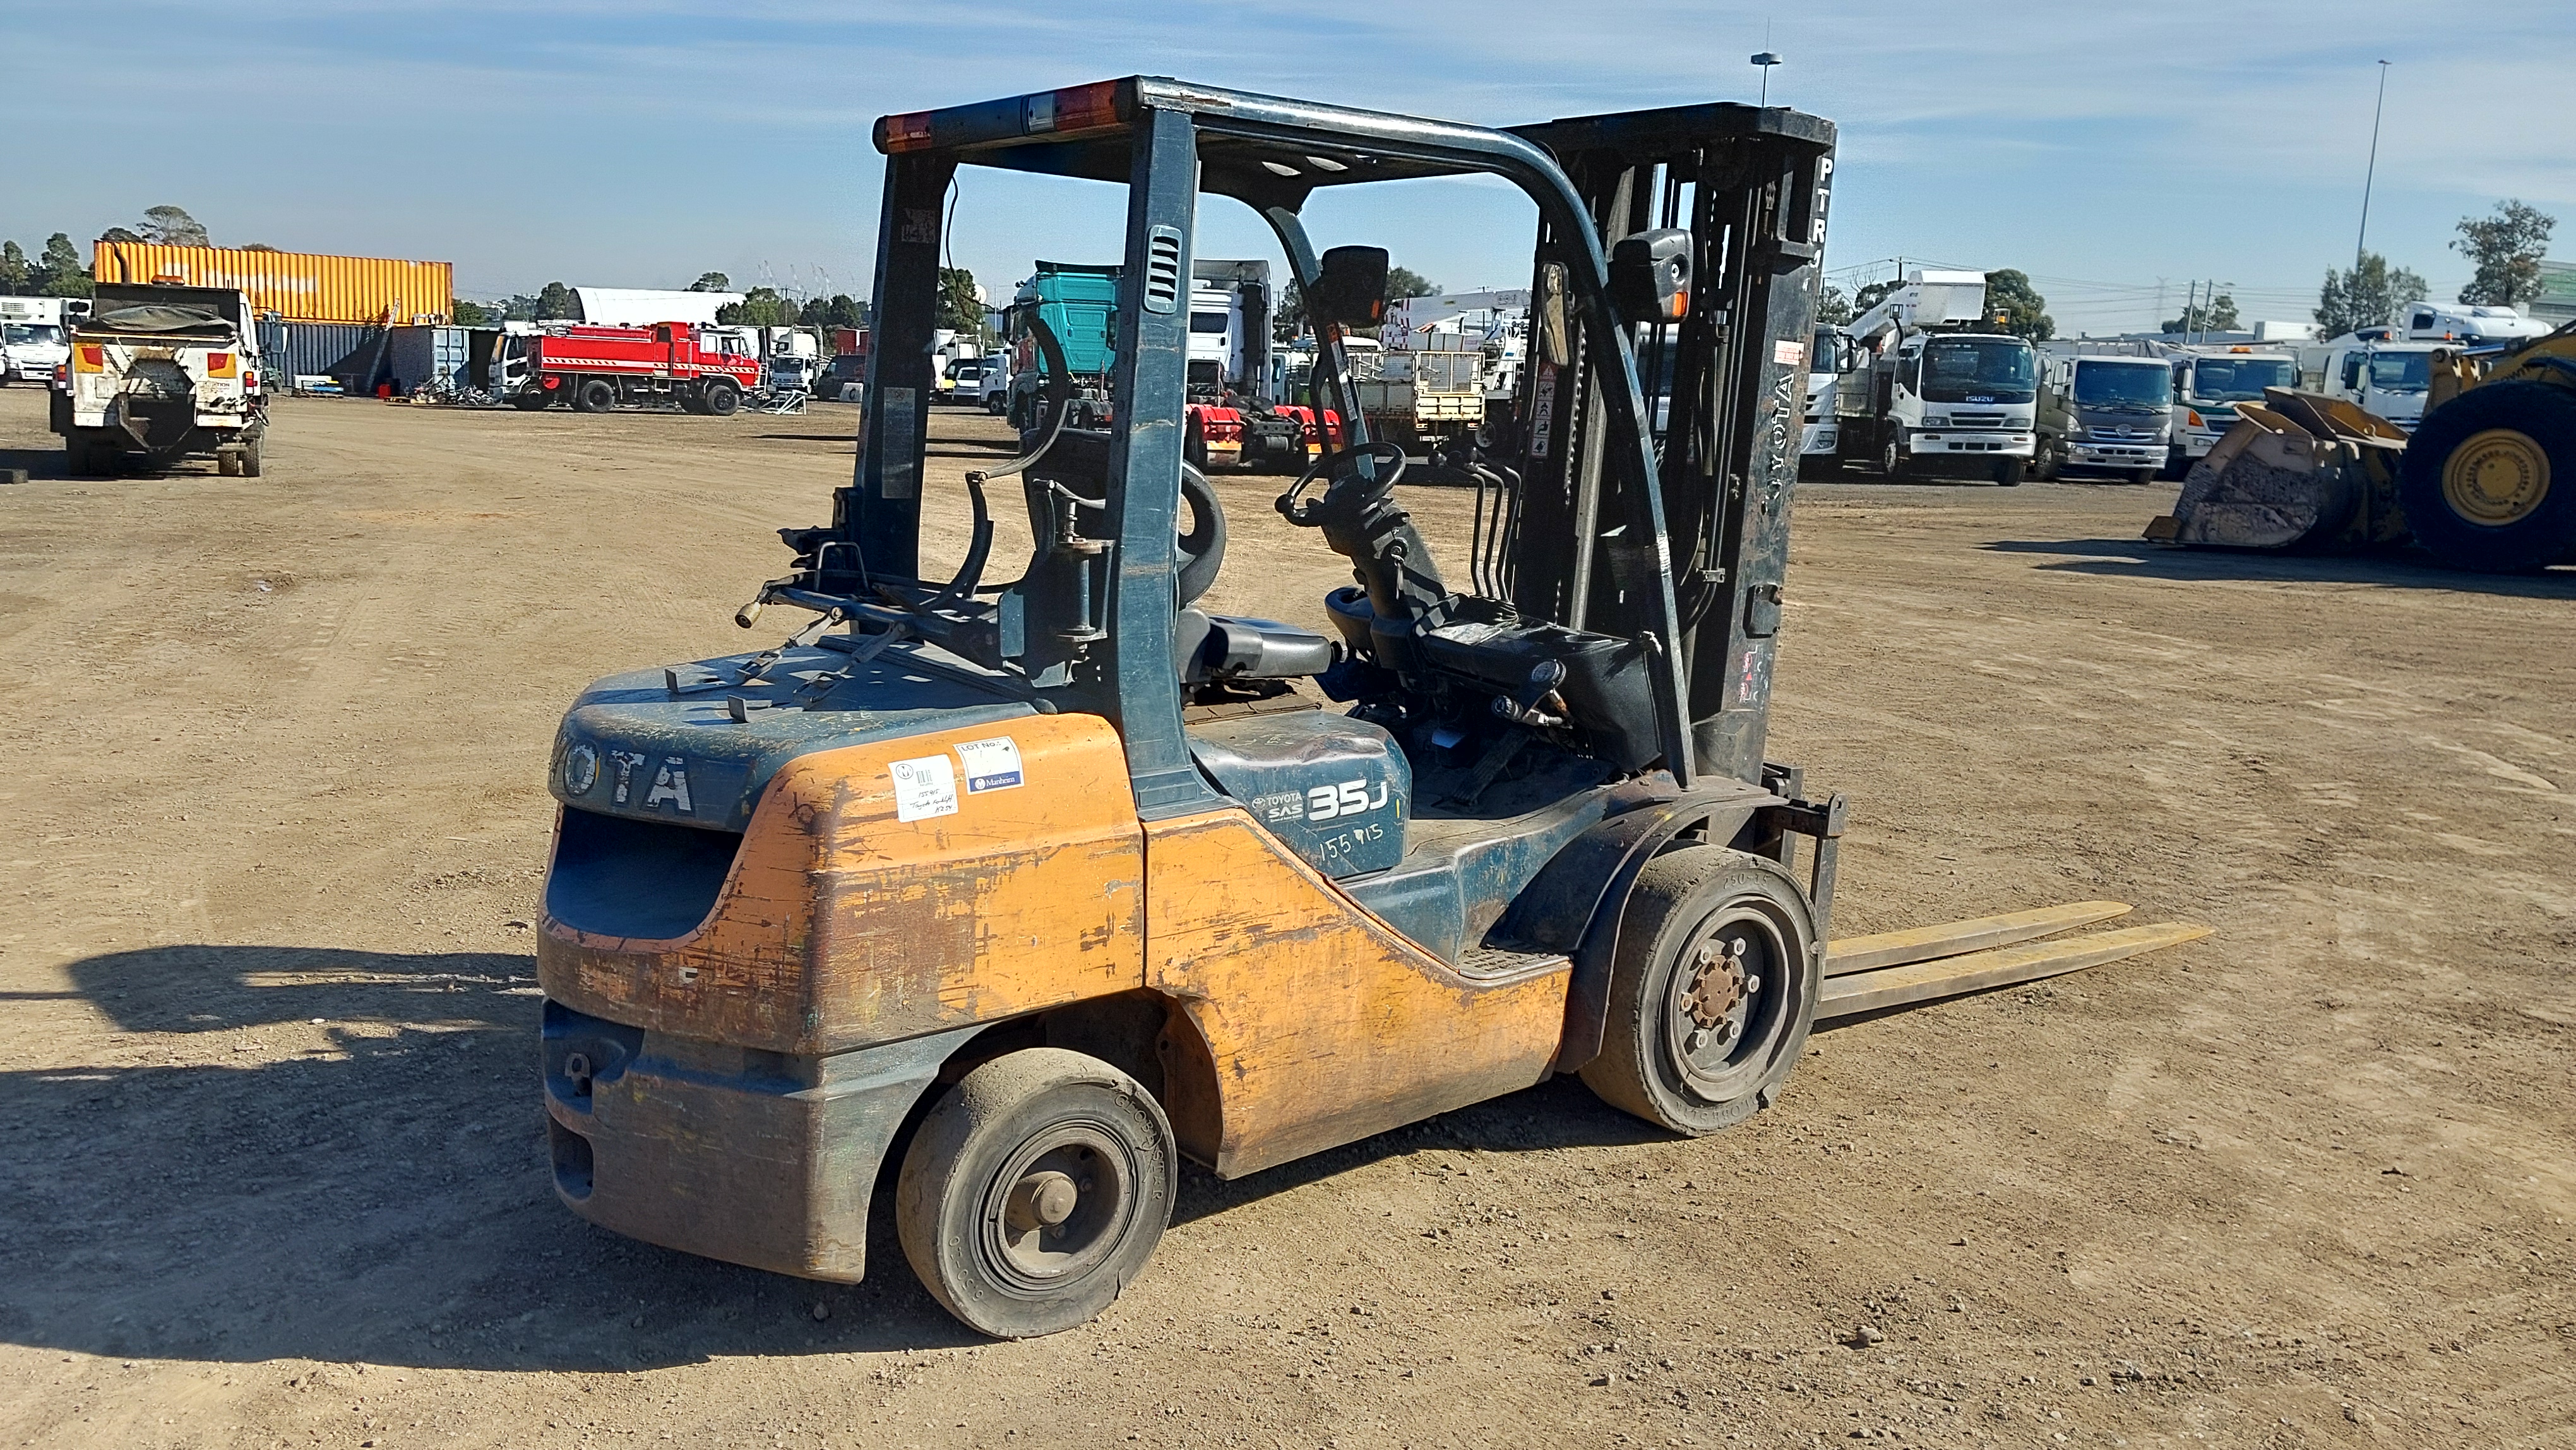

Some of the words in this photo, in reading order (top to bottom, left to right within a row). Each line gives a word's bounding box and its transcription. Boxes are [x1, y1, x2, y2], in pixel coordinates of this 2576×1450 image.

[986, 776, 1015, 787] Manheim
[1266, 791, 1303, 806] TOYOTA
[1308, 778, 1388, 821] 35J
[1268, 803, 1304, 818] SAS
